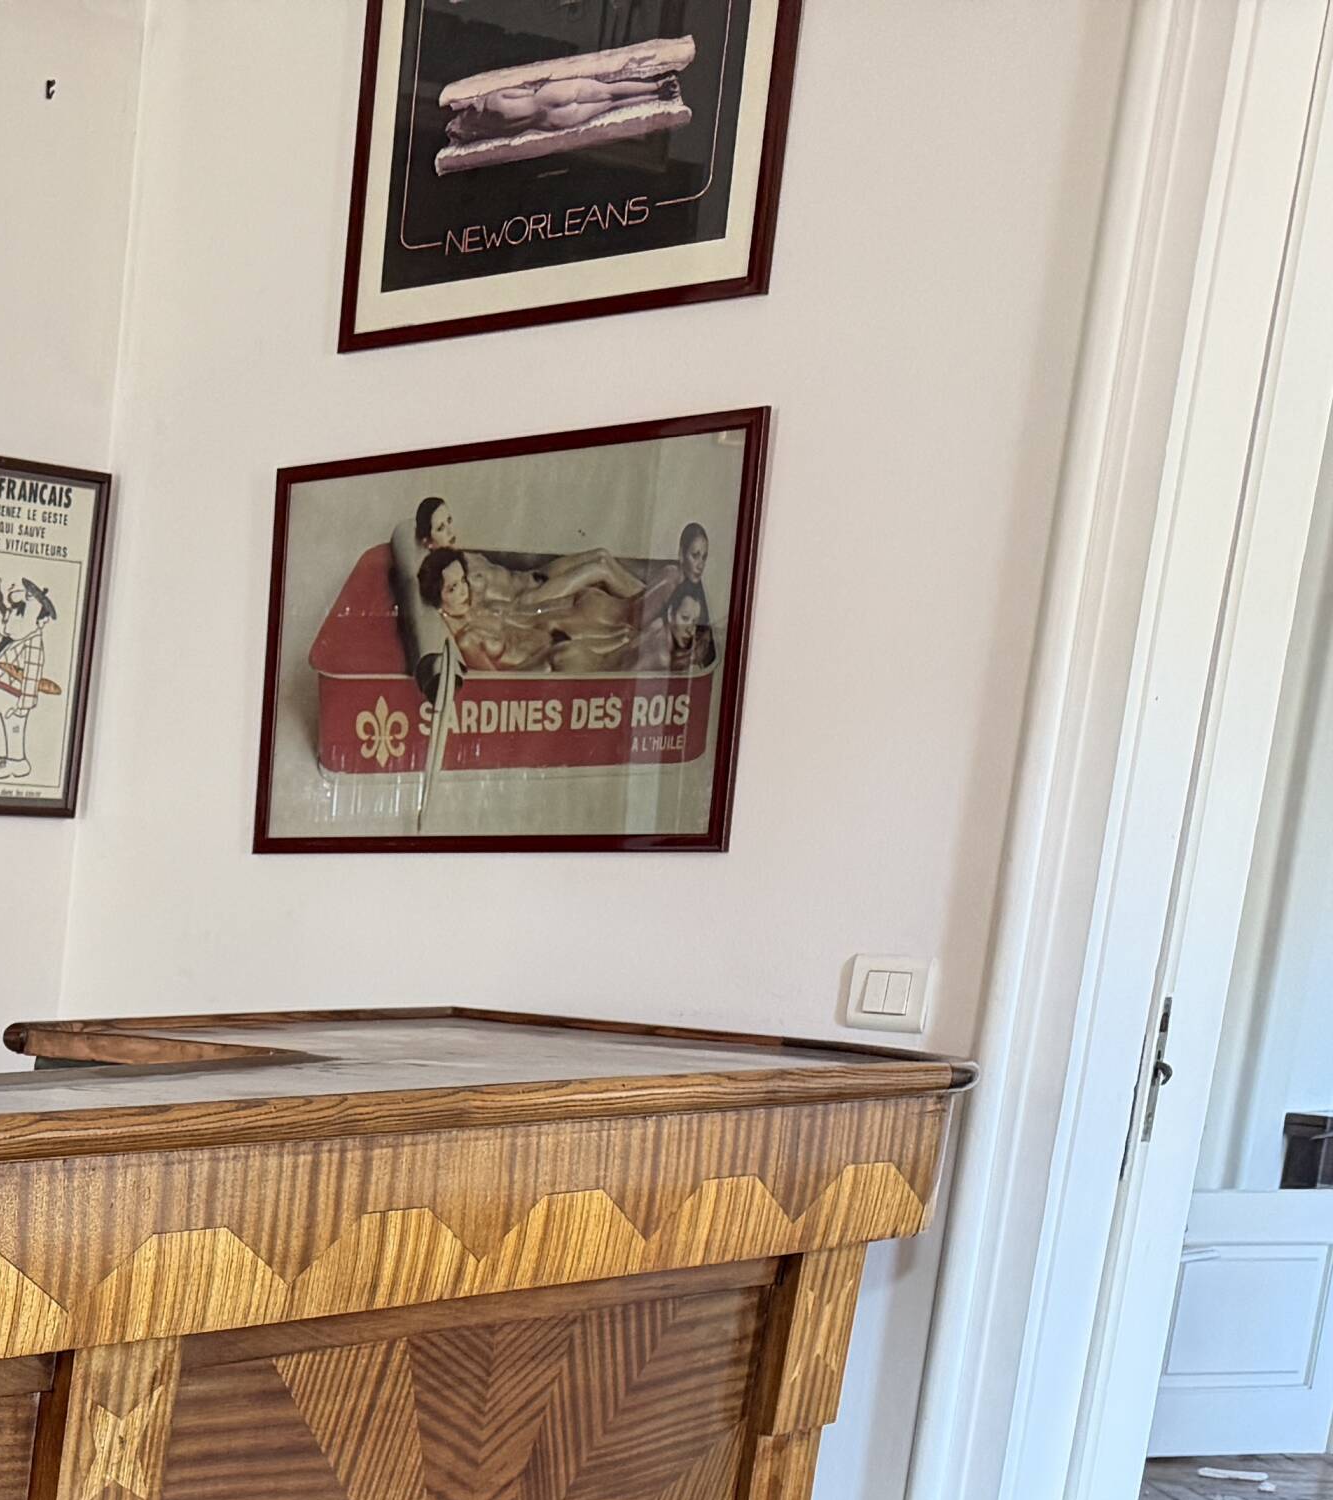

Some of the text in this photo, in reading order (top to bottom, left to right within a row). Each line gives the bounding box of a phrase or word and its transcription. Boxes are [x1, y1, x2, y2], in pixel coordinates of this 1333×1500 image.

[27, 508, 37, 521] LE
[41, 511, 68, 526] GESTE
[17, 524, 46, 540] SAUVE
[6, 538, 68, 558] VITICULTEURS
[419, 694, 690, 736] SARDINES DES ROIS
